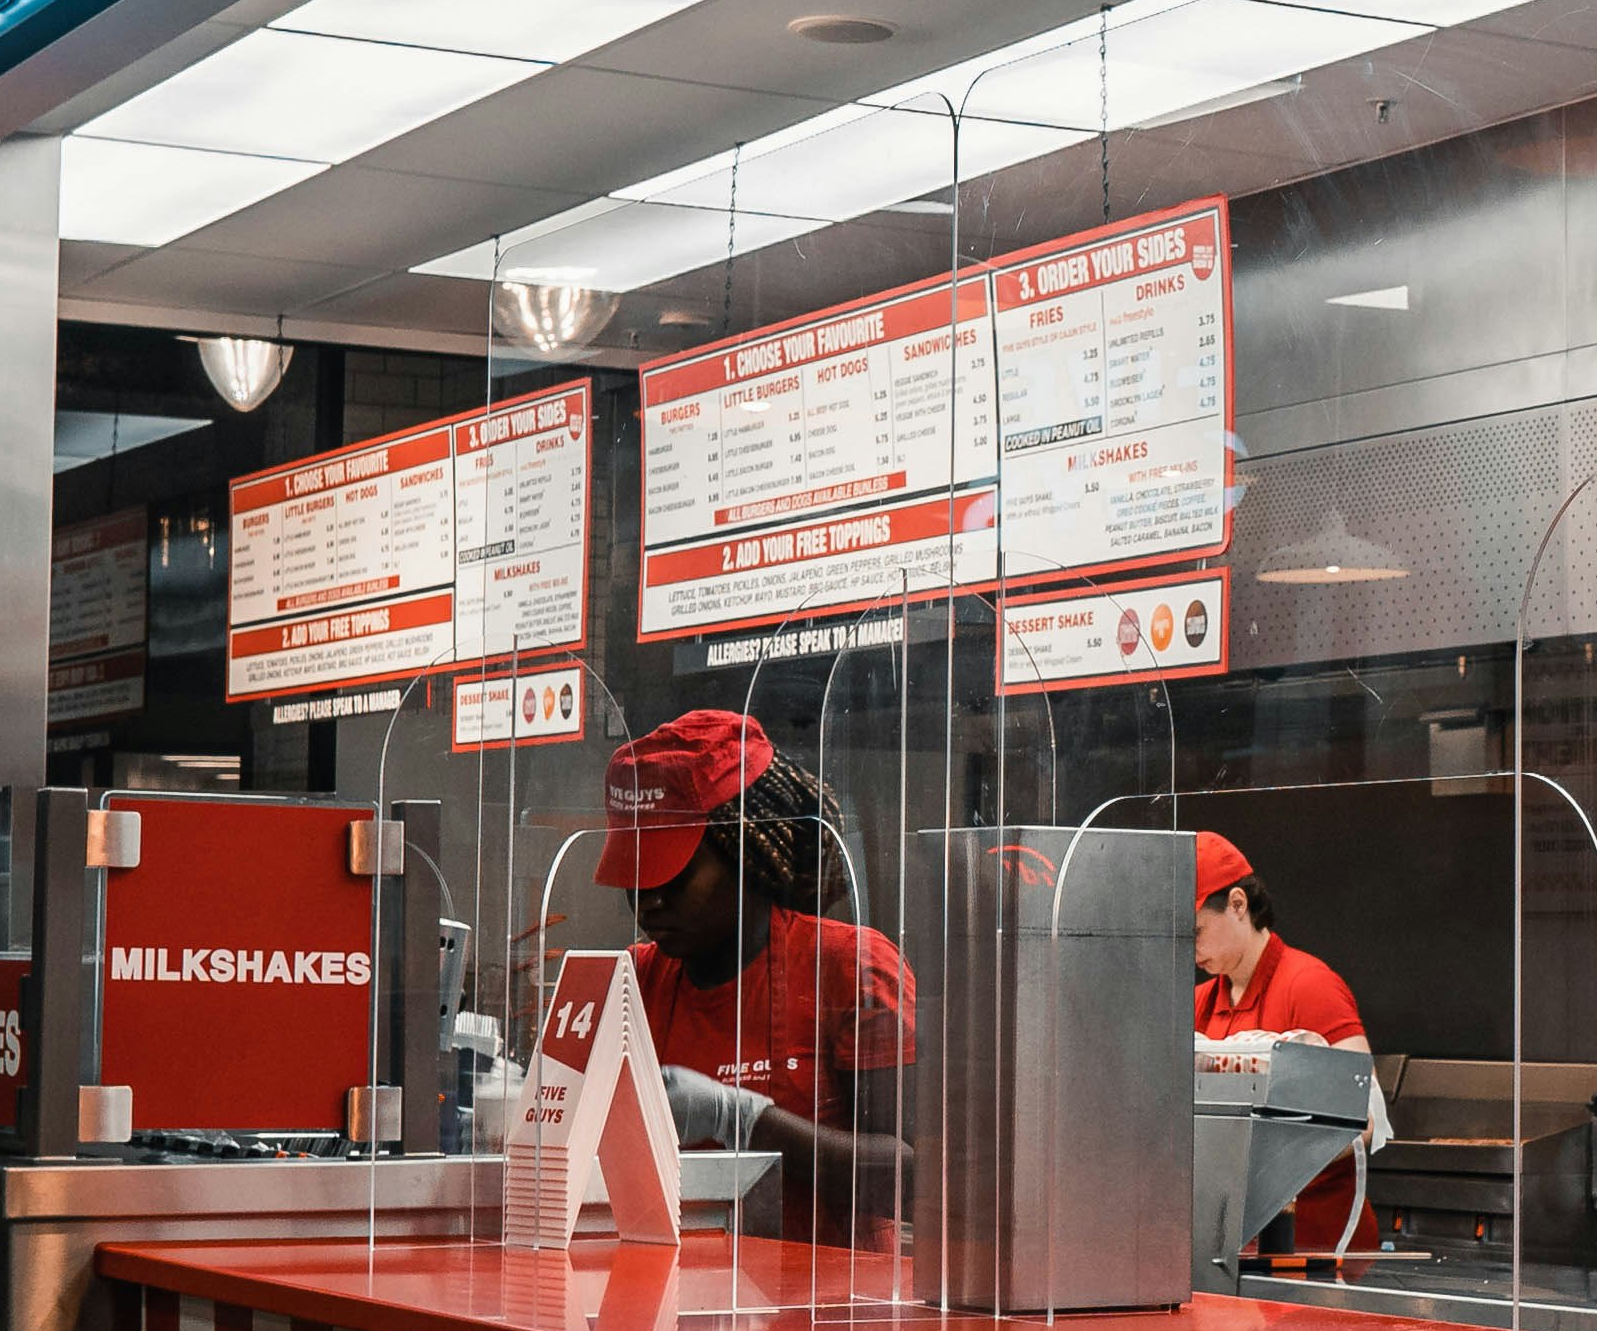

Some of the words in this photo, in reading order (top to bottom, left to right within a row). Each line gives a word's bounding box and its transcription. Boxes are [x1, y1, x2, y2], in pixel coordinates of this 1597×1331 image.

[1019, 271, 1035, 301] 3.
[1037, 254, 1090, 295] ORDER
[1091, 243, 1135, 281] YOUR
[1137, 228, 1186, 268] SIDES
[1136, 274, 1185, 301] DRINKS
[1029, 306, 1064, 329] FRIES
[723, 356, 736, 381] 1.
[736, 341, 783, 378] CHOOSE
[783, 330, 816, 364] YOUR
[816, 311, 885, 355] FAVOURITE
[903, 328, 977, 362] SANDWICHES
[817, 366, 838, 383] HOT
[840, 357, 869, 378] DOGS
[724, 388, 754, 409] LITTLE
[757, 376, 800, 403] BURGERS
[510, 407, 536, 436] YOUR
[538, 399, 566, 430] SIDES
[660, 402, 701, 425] BURGERS
[536, 436, 564, 454] DRINKS
[1005, 431, 1040, 451] COOKED
[1041, 427, 1051, 445] IN
[1051, 420, 1085, 443] PEANUT
[1086, 417, 1102, 433] OIL
[1067, 441, 1148, 472] MILKSHAKES
[294, 468, 324, 495] CHOOSE
[324, 461, 345, 487] YOUR
[345, 448, 389, 482] FAVOURITE
[400, 467, 444, 490] SANDWICHES
[345, 489, 359, 503] HOT
[360, 485, 379, 500] DOGS
[813, 483, 853, 505] AVAILABLE
[285, 504, 305, 519] LITTLE
[306, 496, 335, 515] BURGERS
[242, 513, 270, 530] BURGERS
[722, 545, 734, 571] 2.
[735, 539, 761, 569] ADD
[762, 532, 795, 564] YOUR
[796, 527, 827, 558] FREE
[829, 514, 891, 552] TOPPINGS
[494, 560, 541, 581] MILKSHAKES
[826, 562, 849, 576] GREEN
[884, 550, 914, 567] GRILLED
[291, 625, 308, 646] ADD
[308, 619, 329, 643] YOUR
[330, 614, 350, 639] FREE
[351, 608, 390, 636] TOPPINGS
[1008, 616, 1055, 635] DESSERT
[1057, 610, 1094, 630] SHAKE
[707, 637, 762, 668] ALLERGIES?
[762, 632, 799, 660] PLEASE
[799, 626, 832, 656] SPEAK
[832, 625, 847, 651] TO
[857, 616, 903, 647] MANAGE
[273, 702, 309, 725] ALLERGIES?
[309, 699, 333, 720] PLEASE
[333, 695, 354, 717] SPEAK
[369, 688, 402, 713] MANAGER
[489, 688, 508, 702] SHAKE
[624, 787, 665, 802] GUYS
[111, 946, 372, 986] MILKSHAKES
[555, 1001, 596, 1040] 14
[717, 1062, 750, 1077] FIVE
[753, 1057, 799, 1072] GUS
[535, 1086, 567, 1101] FIVE
[525, 1107, 564, 1124] GUYS
